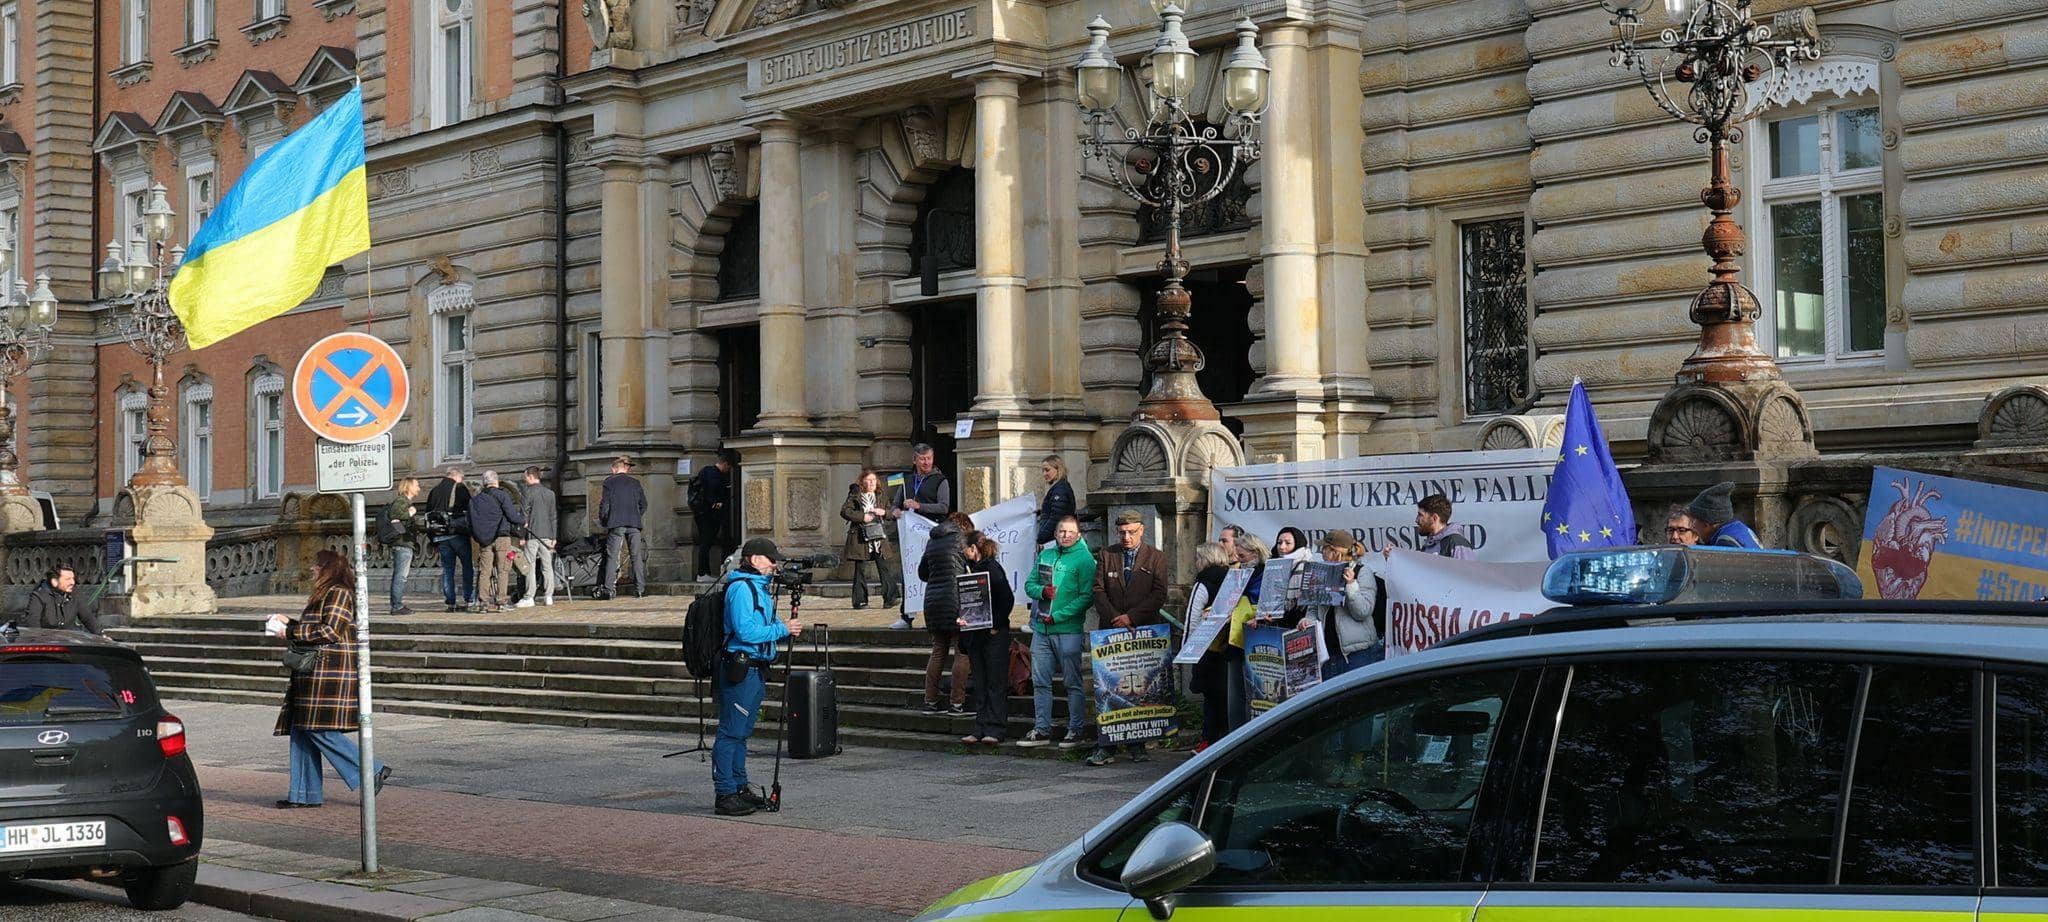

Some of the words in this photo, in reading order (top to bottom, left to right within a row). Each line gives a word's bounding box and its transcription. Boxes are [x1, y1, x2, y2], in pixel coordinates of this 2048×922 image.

[333, 459, 345, 468] der
[349, 457, 375, 467] Polizei
[1224, 486, 1299, 511] SOLLTE
[1304, 483, 1342, 509] DIE
[1350, 478, 1465, 507] UKRAINE
[1955, 509, 2048, 557] #INDEPE
[1136, 629, 1153, 640] ARE
[1392, 601, 1462, 651] RUSSIA
[1096, 643, 1122, 658] WAR
[1124, 638, 1168, 652] CRIMES?
[1121, 710, 1132, 718] not
[1101, 720, 1150, 735] SOLIDARITY
[1150, 719, 1169, 728] WITH
[1108, 733, 1125, 742] THE
[1126, 727, 1162, 740] ACCUSED
[8, 829, 29, 845] HH
[41, 826, 61, 844] JL
[66, 823, 104, 841] 1336
